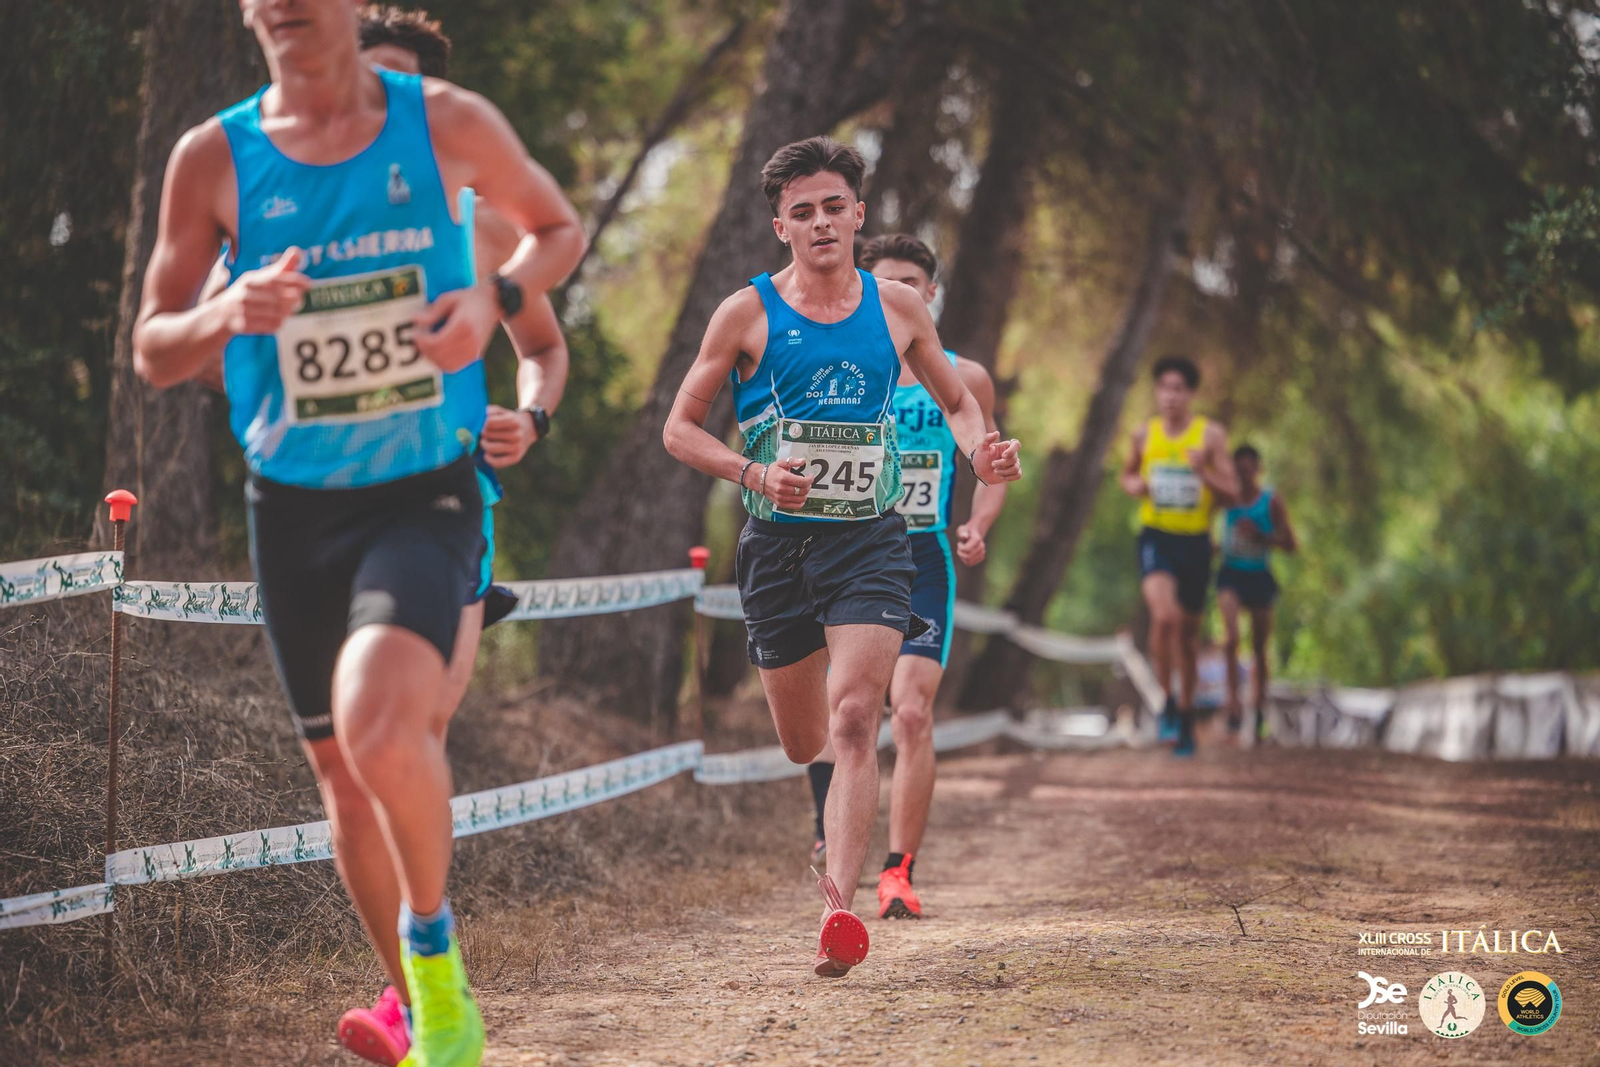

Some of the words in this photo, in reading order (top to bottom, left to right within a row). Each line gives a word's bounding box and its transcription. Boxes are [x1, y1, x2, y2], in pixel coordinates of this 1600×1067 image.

[296, 321, 420, 382] 8285
[810, 365, 834, 391] ATLETISMO
[812, 367, 825, 381] CLUB
[841, 361, 866, 396] ORIPPO
[806, 390, 824, 398] DOS
[818, 397, 862, 406] HERMANAS
[809, 424, 861, 440] ITÁLICA
[902, 481, 932, 507] 73
